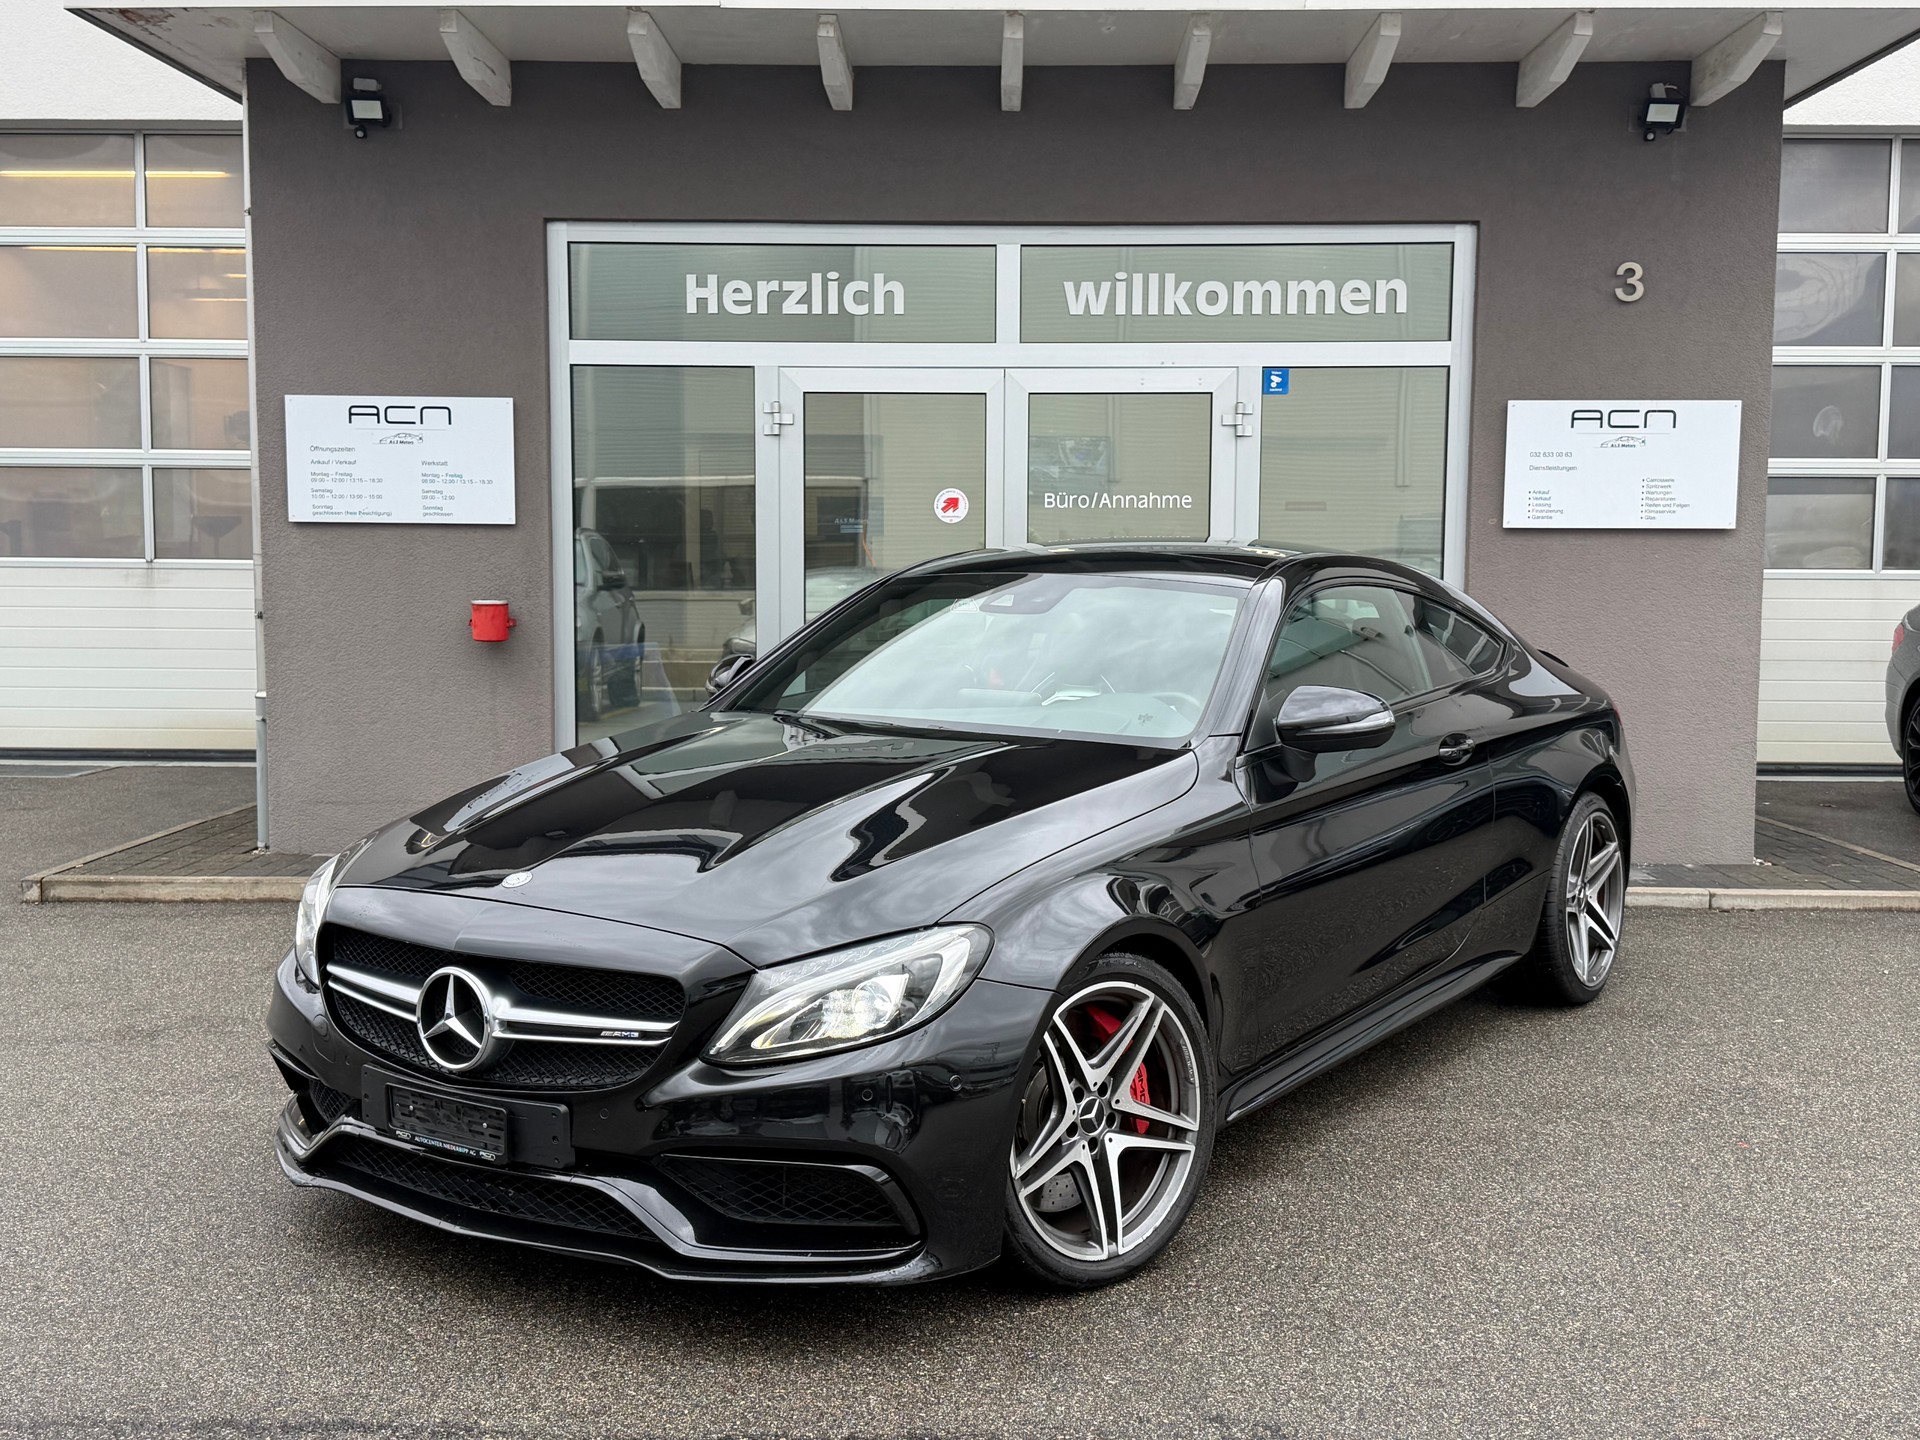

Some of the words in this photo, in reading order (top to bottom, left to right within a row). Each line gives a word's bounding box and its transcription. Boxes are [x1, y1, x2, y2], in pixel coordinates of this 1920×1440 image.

[1615, 261, 1644, 302] 3
[685, 271, 905, 315] Herzlich
[1063, 271, 1408, 316] willkommen
[348, 405, 452, 426] ACN
[1570, 409, 1677, 429] ACN
[310, 445, 355, 453] Öffnungszeiten
[1044, 492, 1192, 509] Büro/Annahme
